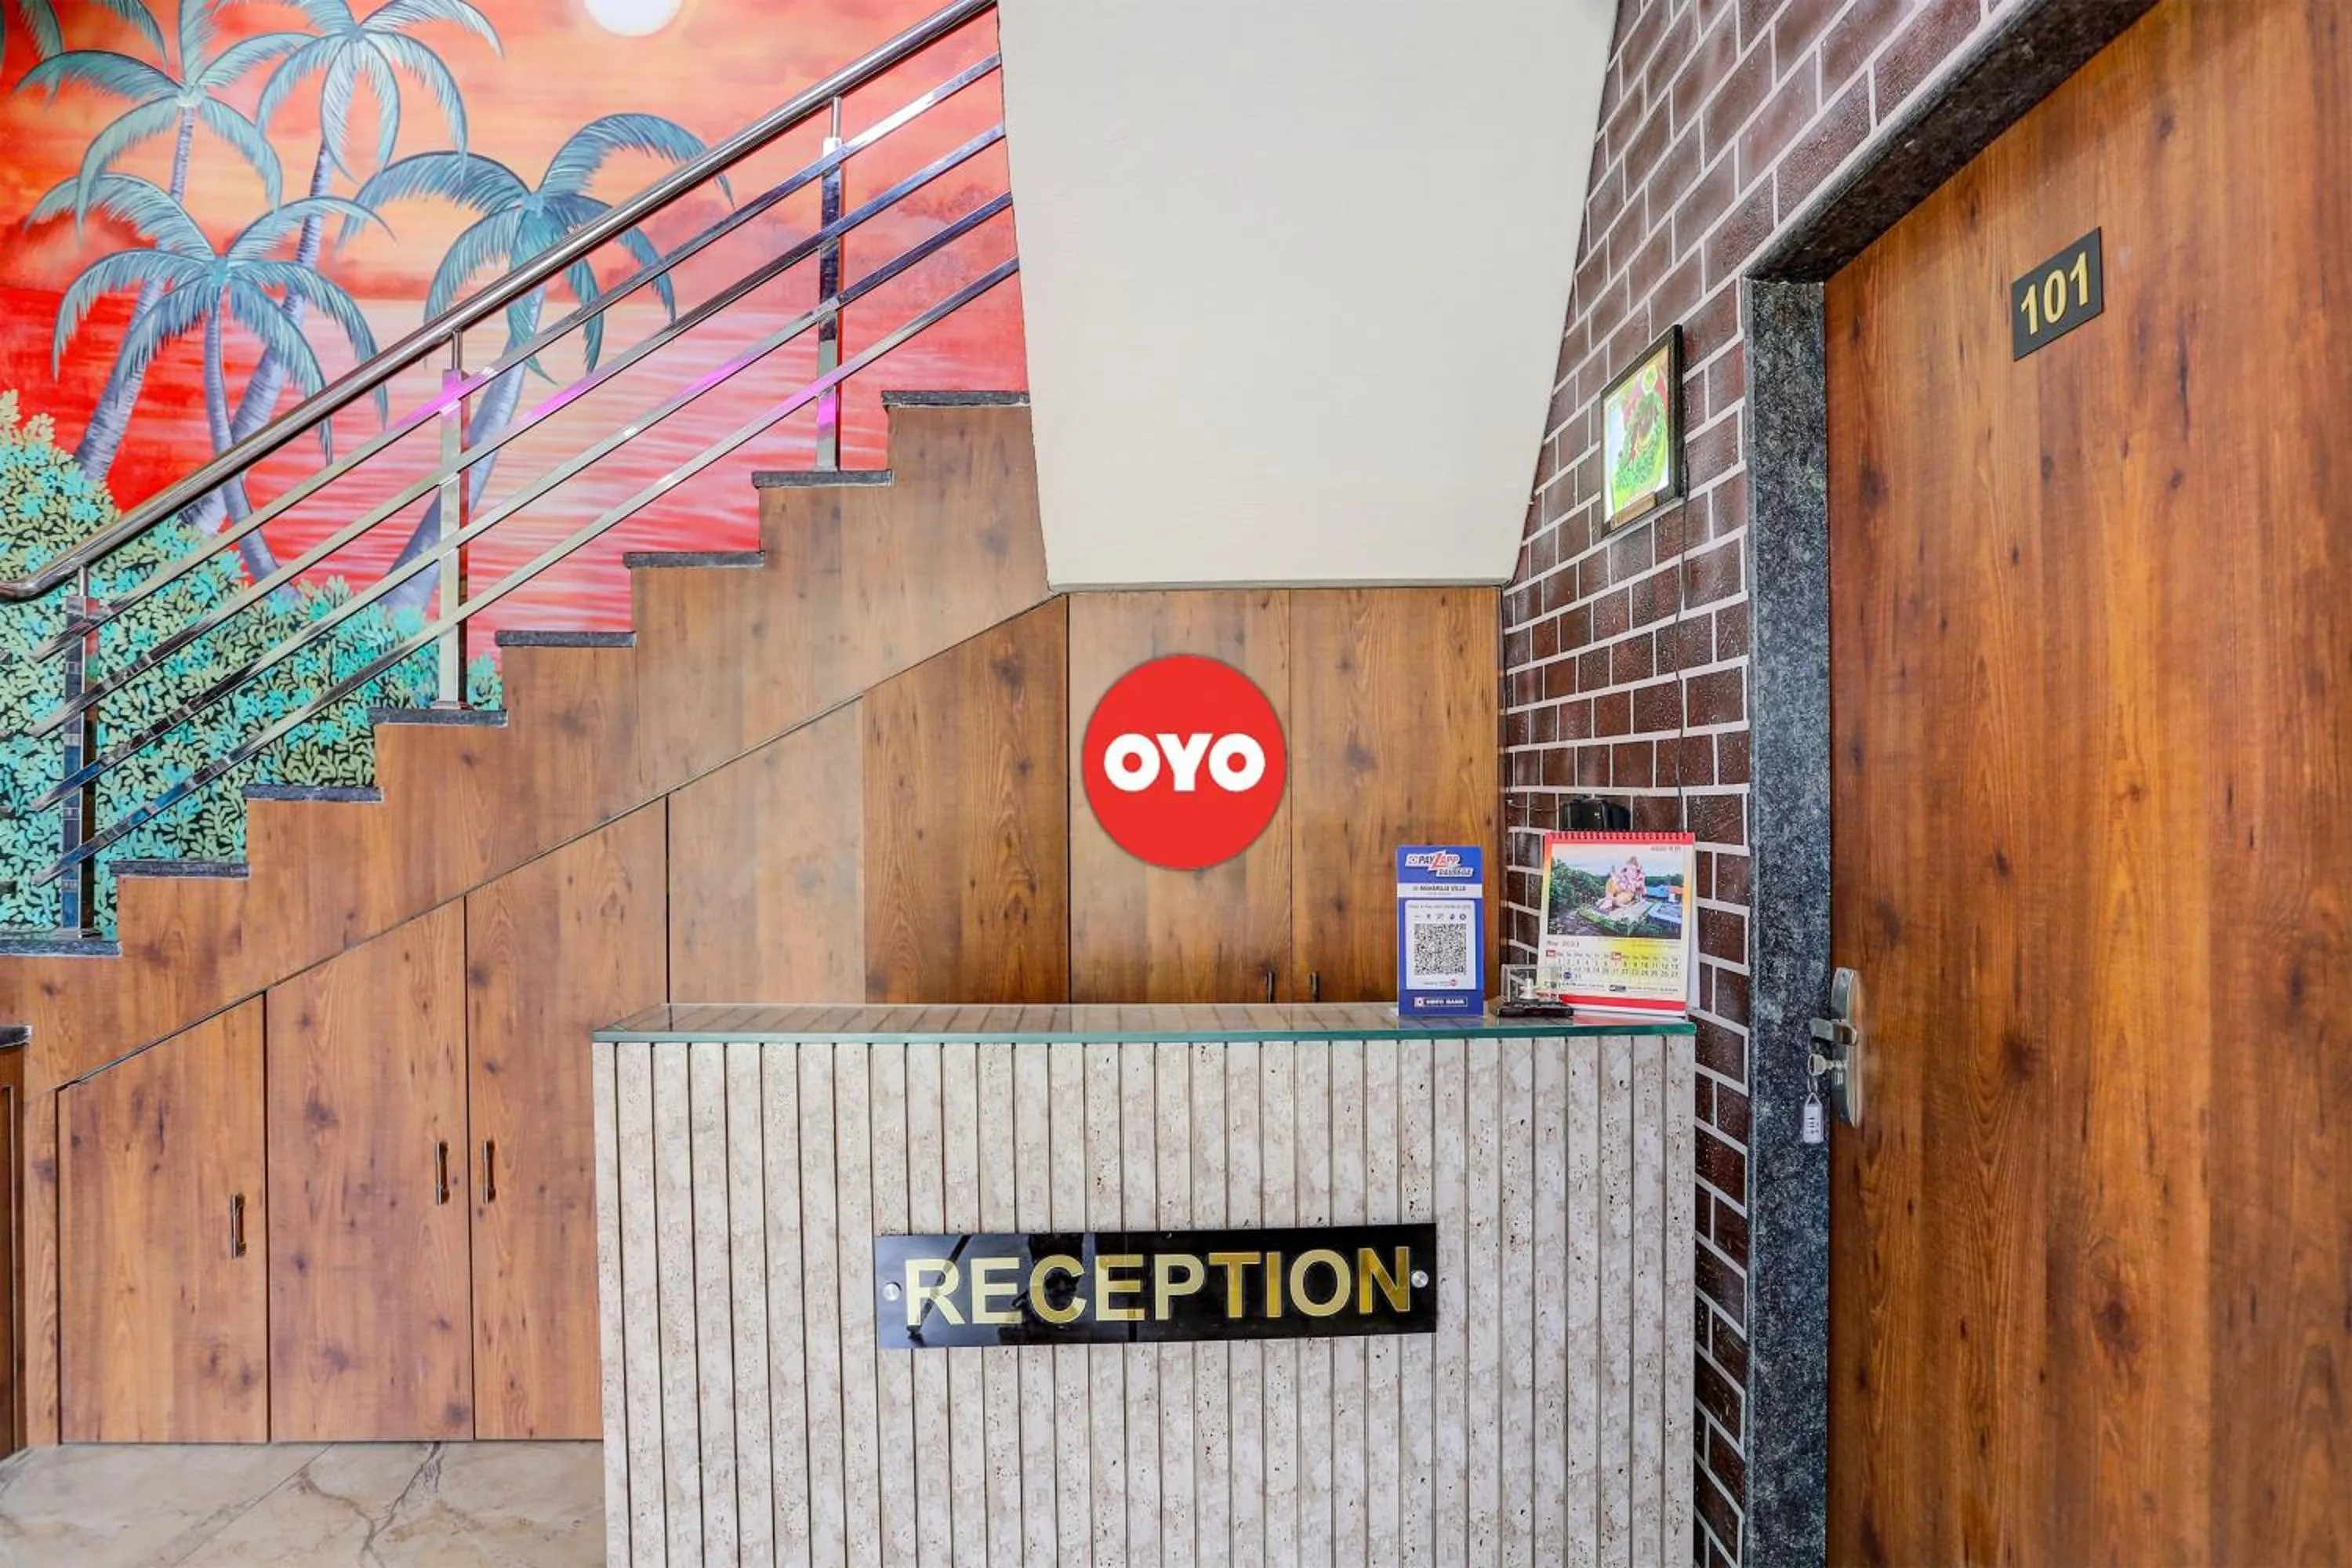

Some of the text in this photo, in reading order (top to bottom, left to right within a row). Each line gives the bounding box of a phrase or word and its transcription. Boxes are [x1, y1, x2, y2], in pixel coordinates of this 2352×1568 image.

[2020, 250, 2089, 336] 101
[1104, 732, 1265, 792] OYO
[904, 1247, 1410, 1326] RECEPTION
